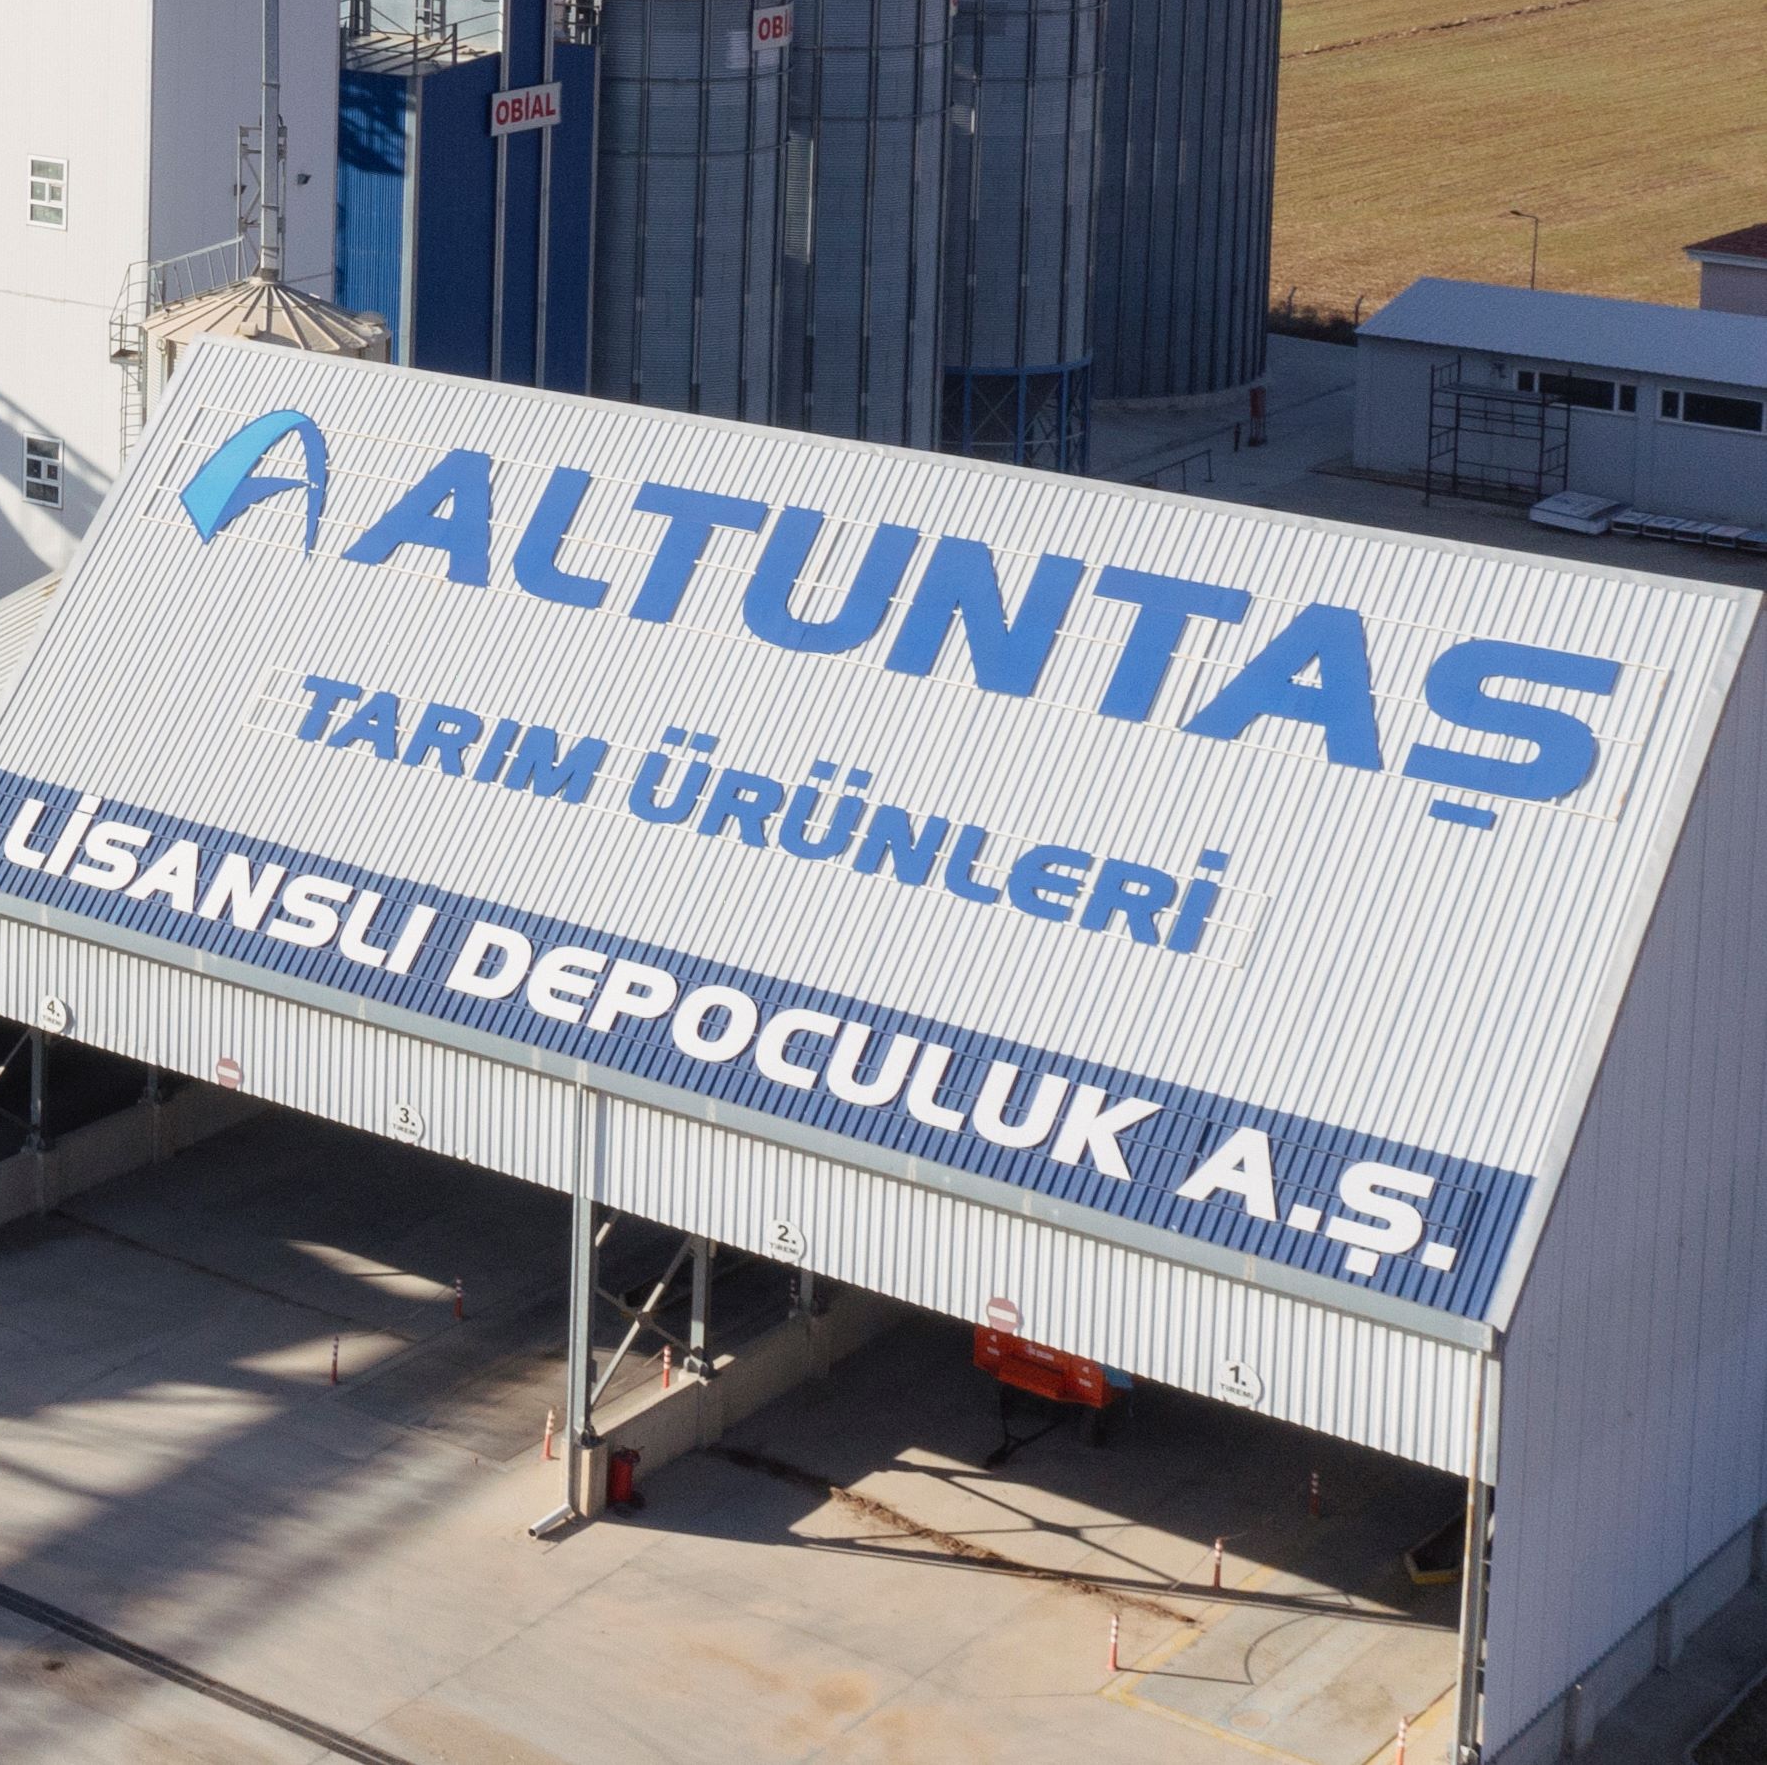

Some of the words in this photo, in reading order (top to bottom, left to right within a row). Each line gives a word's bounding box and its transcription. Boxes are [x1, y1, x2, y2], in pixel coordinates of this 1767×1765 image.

[495, 90, 556, 125] OBİAL
[342, 448, 1621, 829] ALTUNTAŞ
[298, 674, 608, 804] TARIM
[627, 726, 1228, 954] ÜRÜNLERİ
[3, 794, 437, 975] LİSANSLI
[445, 920, 1163, 1183] DEPOCULUK
[1176, 1126, 1458, 1277] A.Ş.
[399, 1107, 416, 1127] 3.
[777, 1224, 797, 1245] 2.
[1229, 1365, 1247, 1386] 1.
